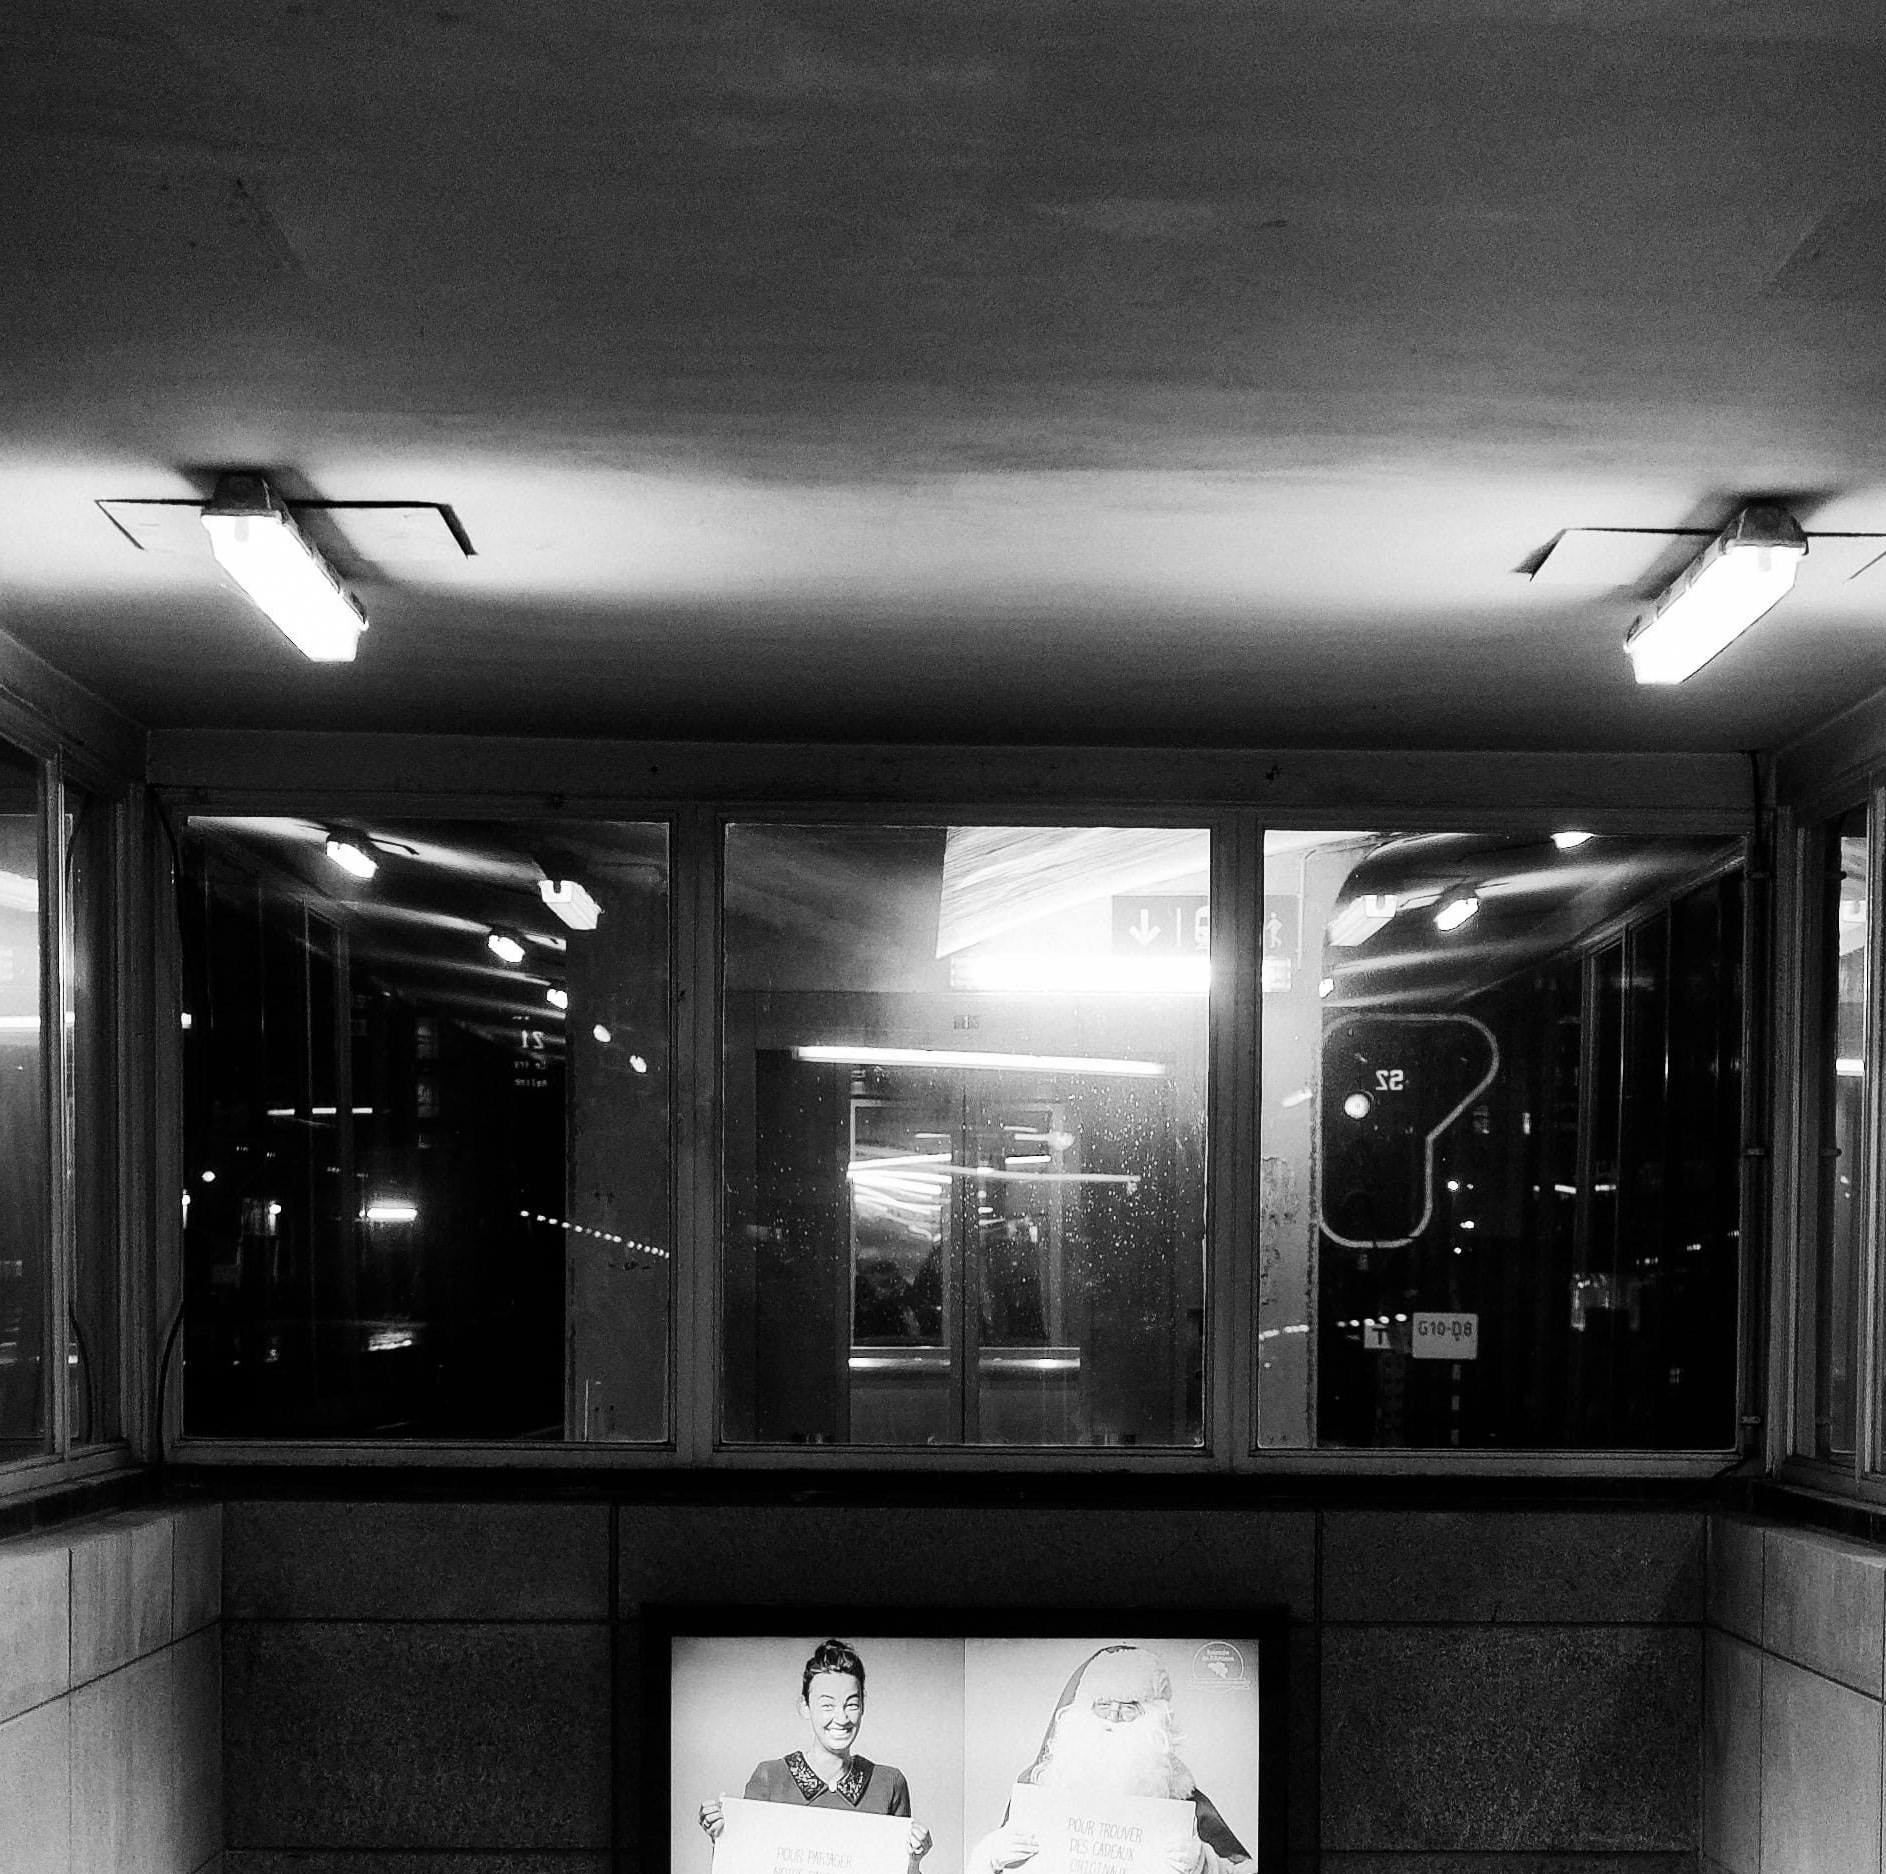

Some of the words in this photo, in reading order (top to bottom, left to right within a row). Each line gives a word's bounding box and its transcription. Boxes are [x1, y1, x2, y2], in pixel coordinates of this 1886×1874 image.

[1067, 1817, 1096, 1836] POUR
[1100, 1822, 1144, 1843] TROUVER
[776, 1847, 804, 1864] POUR
[807, 1850, 853, 1868] PARTAGER
[1069, 1838, 1089, 1854] DES
[1092, 1841, 1135, 1862] CADEAUX
